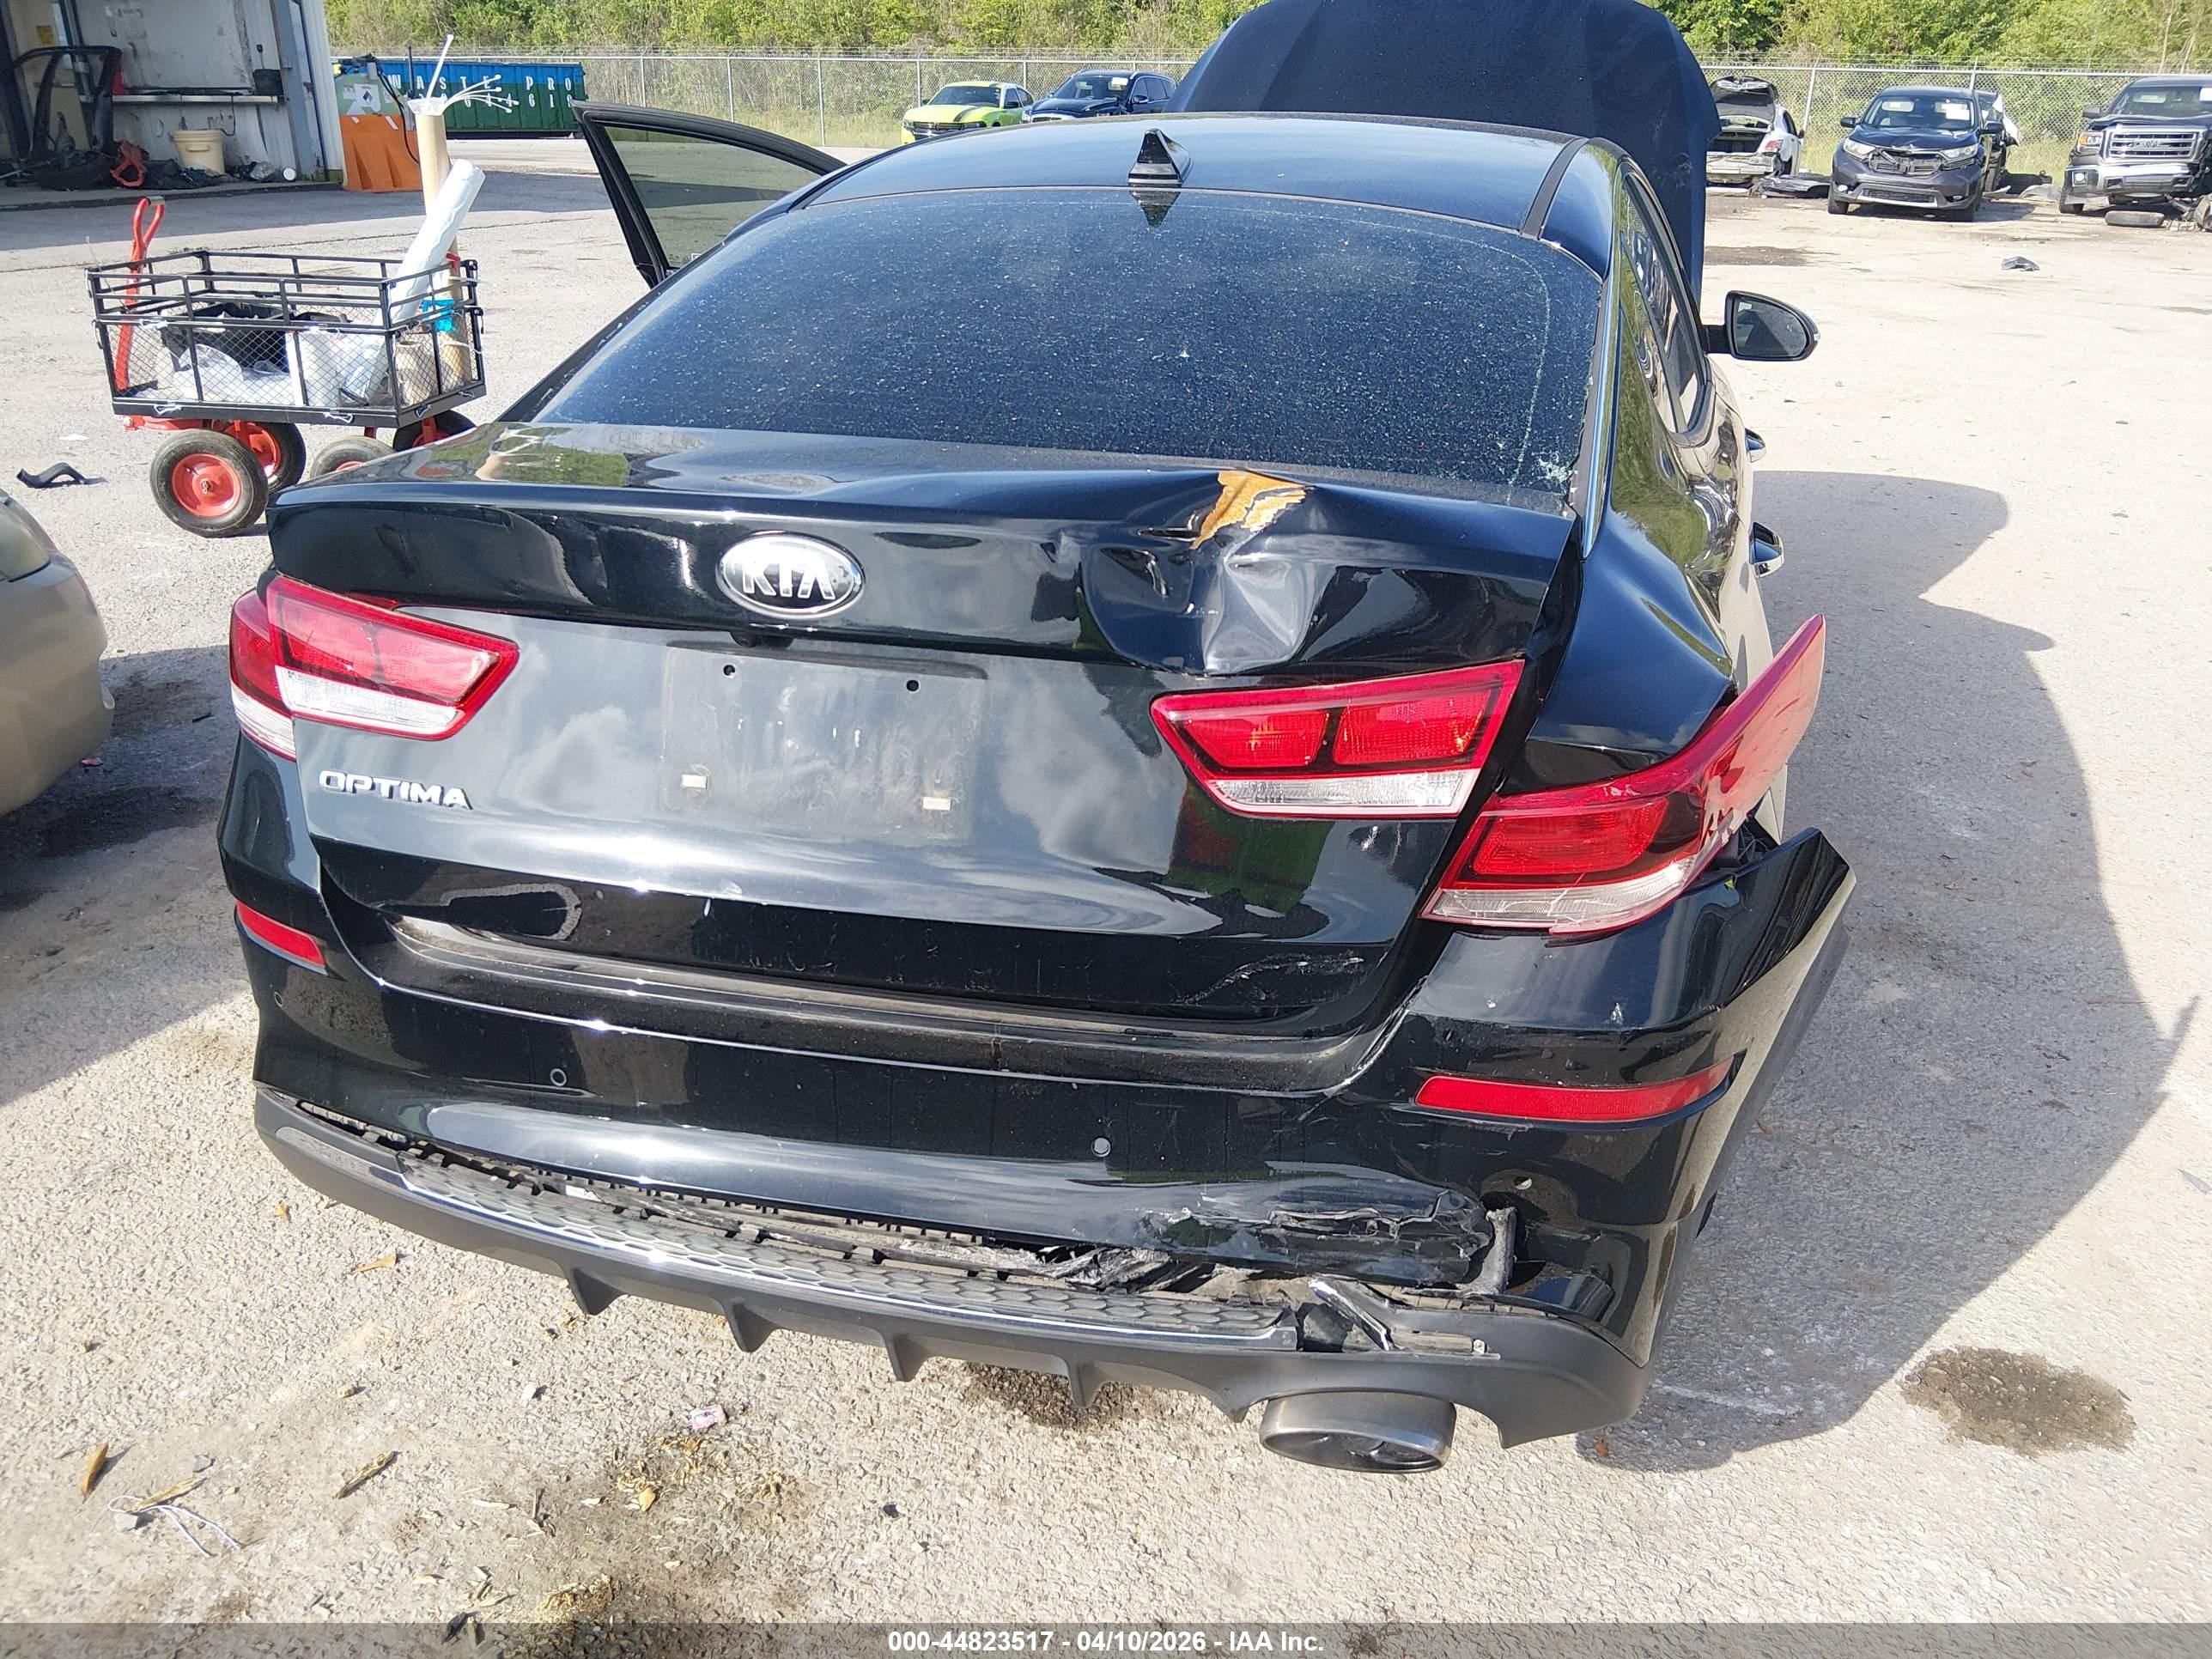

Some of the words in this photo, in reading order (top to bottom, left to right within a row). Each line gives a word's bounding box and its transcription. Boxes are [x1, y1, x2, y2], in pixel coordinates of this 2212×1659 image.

[387, 74, 493, 90] WASTE
[526, 76, 573, 92] PRO
[740, 556, 836, 600] KIA
[319, 770, 473, 811] OPTIMA
